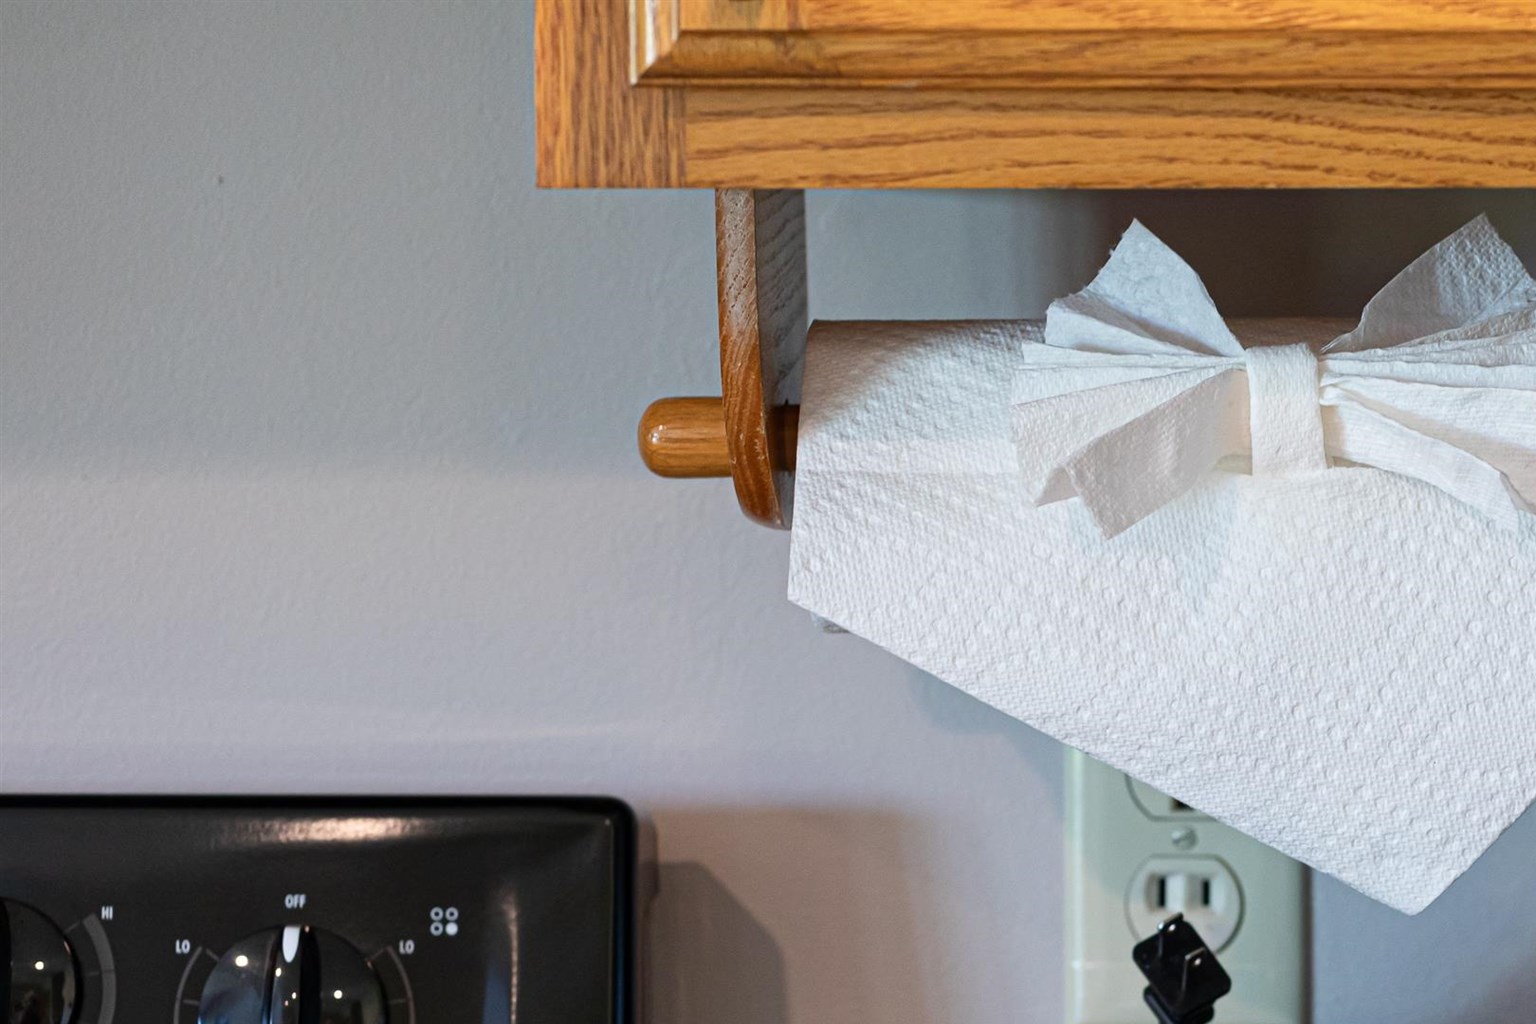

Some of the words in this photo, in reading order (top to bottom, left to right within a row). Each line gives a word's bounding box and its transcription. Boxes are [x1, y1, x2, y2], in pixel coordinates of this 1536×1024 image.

[284, 894, 306, 909] OFF
[101, 906, 113, 920] HI
[175, 939, 191, 954] LO
[399, 939, 415, 954] LO
